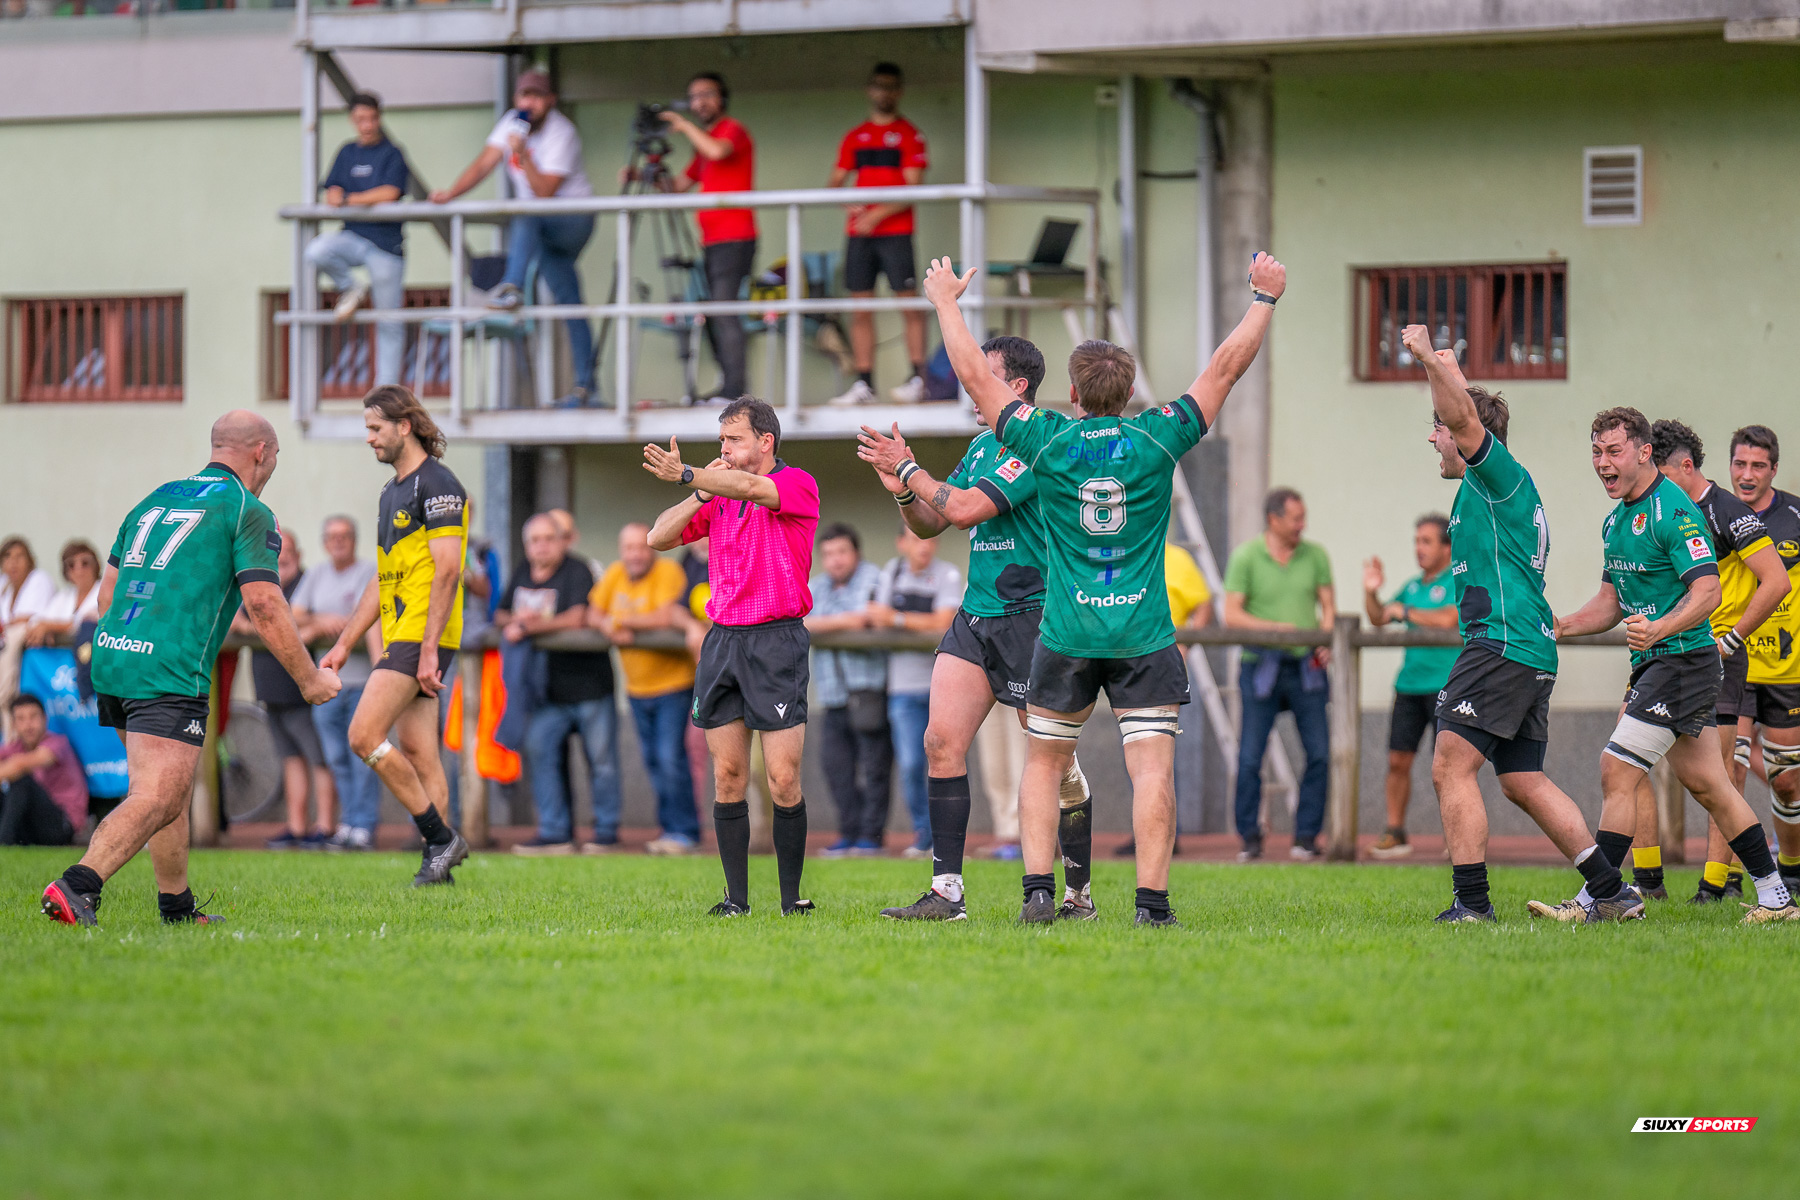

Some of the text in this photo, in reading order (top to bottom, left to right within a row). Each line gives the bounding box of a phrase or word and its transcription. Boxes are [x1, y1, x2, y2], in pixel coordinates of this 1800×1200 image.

[424, 494, 463, 508] FANGA
[426, 503, 463, 516] LOKA
[1078, 476, 1127, 535] 8
[123, 506, 206, 571] 17
[973, 538, 1015, 551] Intxausti
[1076, 587, 1147, 608] Ondoan
[97, 631, 154, 655] Ondoan
